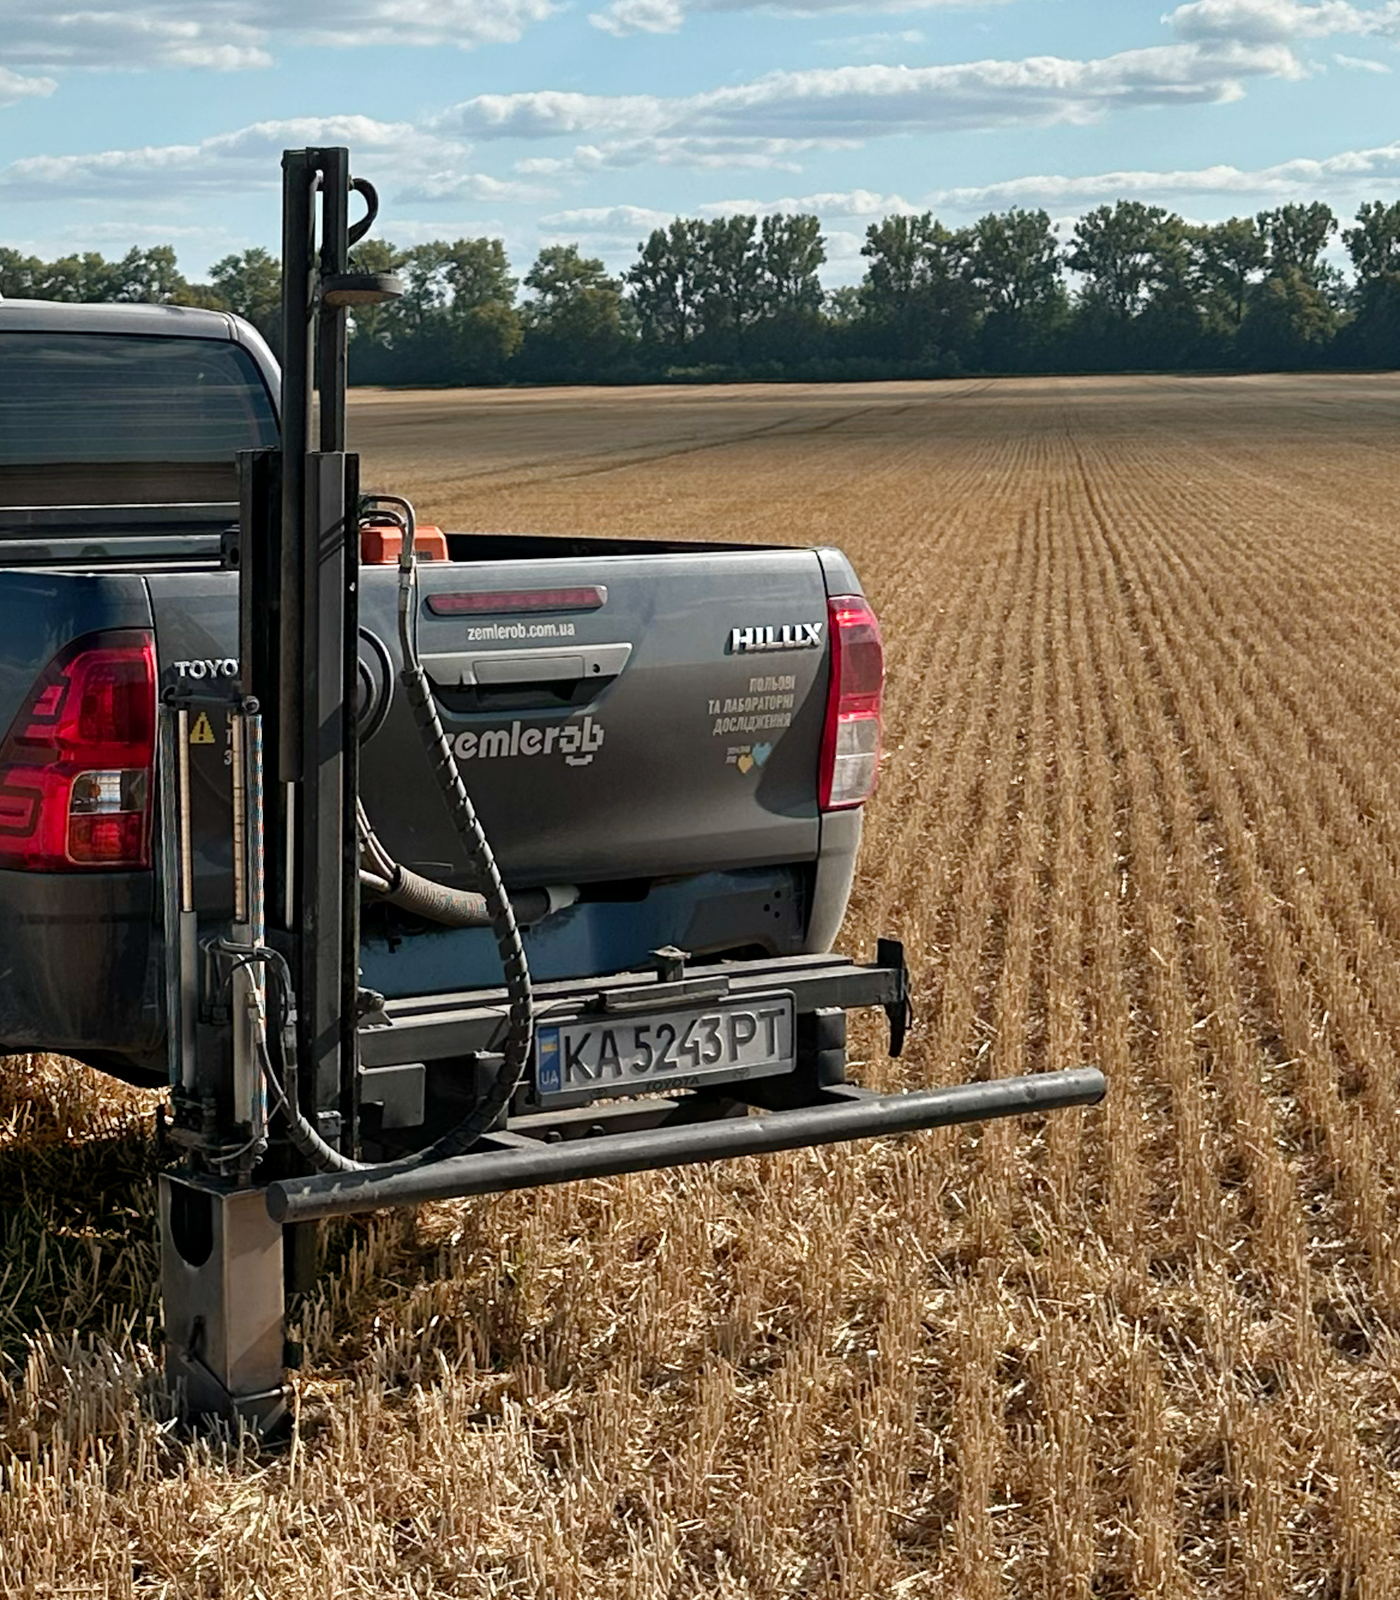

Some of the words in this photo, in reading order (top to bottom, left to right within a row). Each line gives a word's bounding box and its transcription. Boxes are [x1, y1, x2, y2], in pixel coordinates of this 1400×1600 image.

[467, 623, 575, 641] zemlerob.com.ua
[730, 623, 823, 651] HILUX
[173, 659, 239, 679] TOYO
[749, 675, 796, 693] ПОЛЬОВІ
[708, 700, 721, 715] ТА
[723, 694, 795, 713] ЛАБОРАТОРНІ
[712, 712, 792, 736] ДОСЛІДЖЕННЯ
[563, 1029, 623, 1083] KA
[541, 1070, 559, 1086] UA
[645, 1076, 700, 1091] TOYOTA
